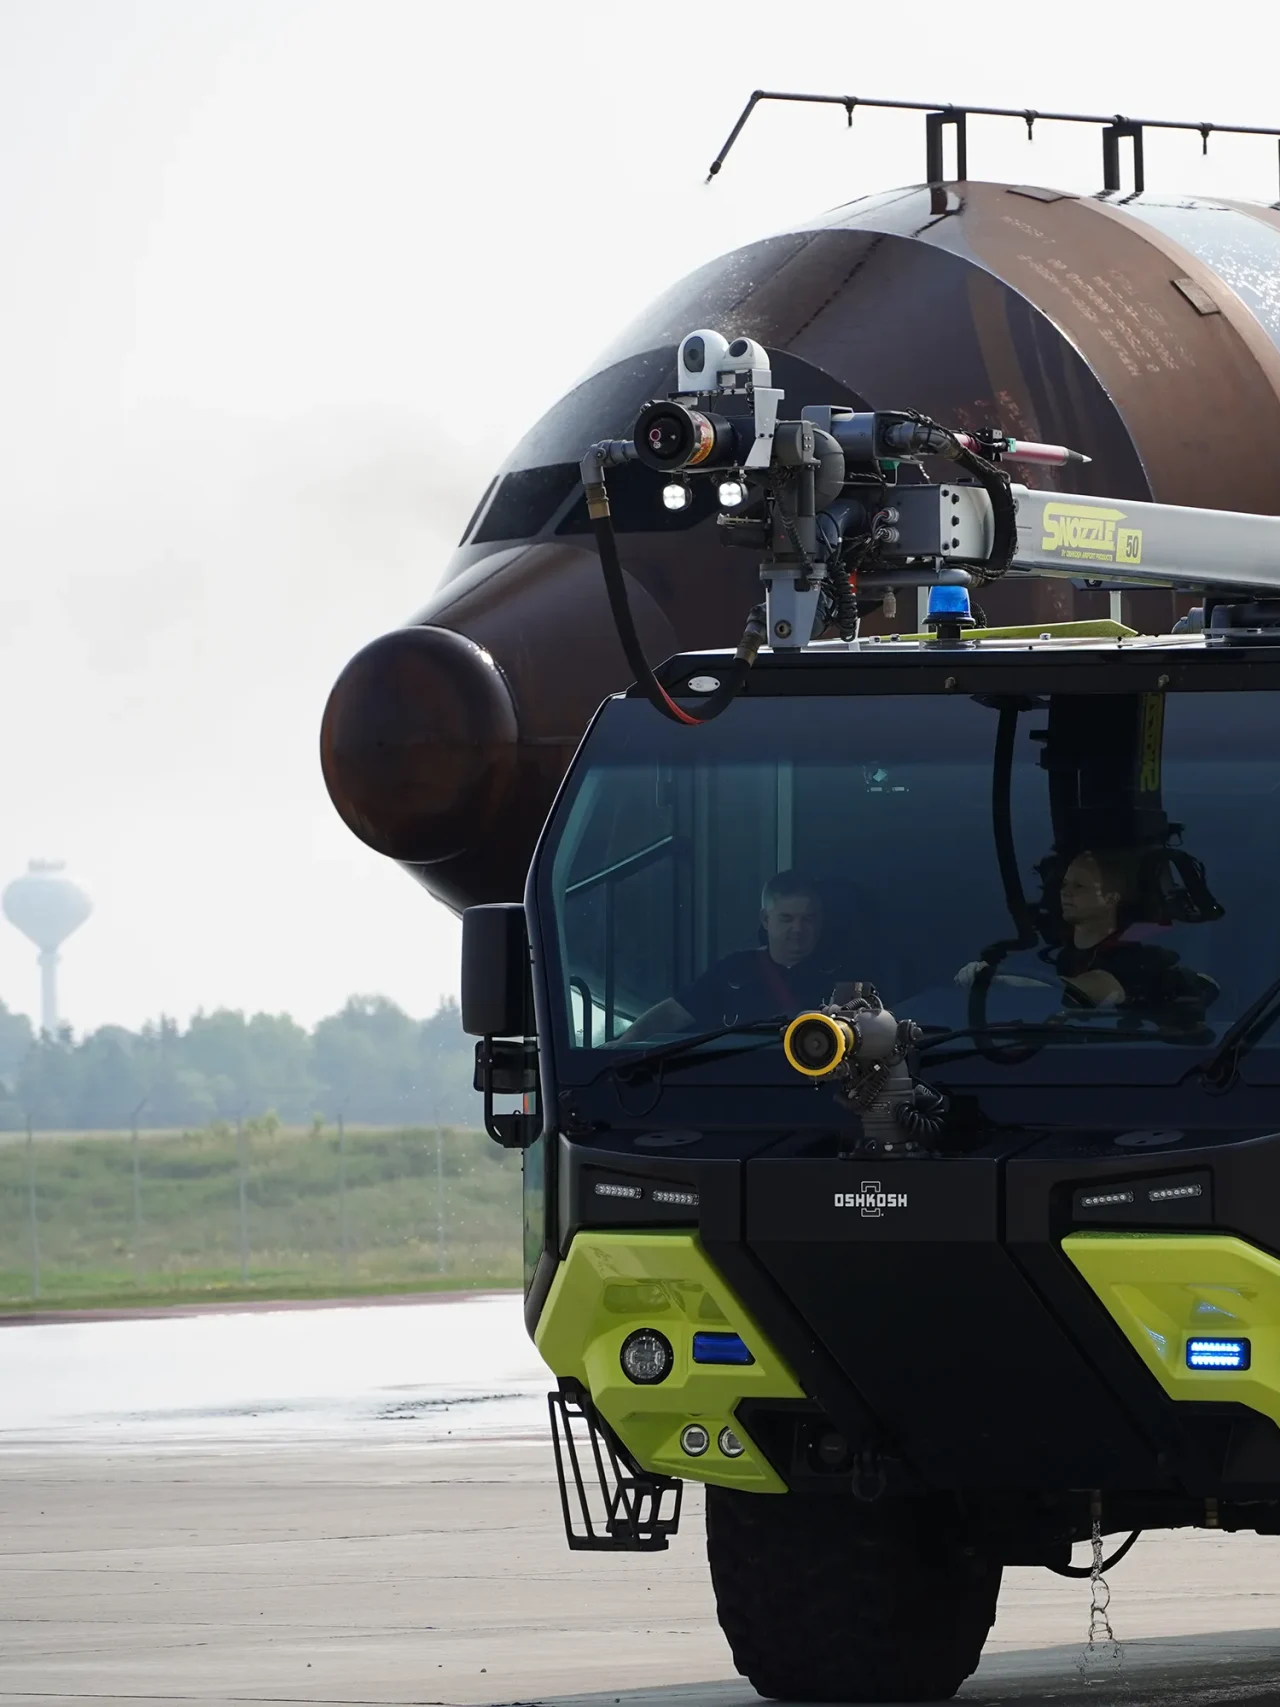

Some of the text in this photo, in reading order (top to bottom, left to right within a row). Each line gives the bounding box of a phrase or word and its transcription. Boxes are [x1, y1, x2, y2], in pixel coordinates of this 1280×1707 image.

[1042, 502, 1139, 558] SNOZZLE 50
[834, 1193, 907, 1207] OSHKOSH
